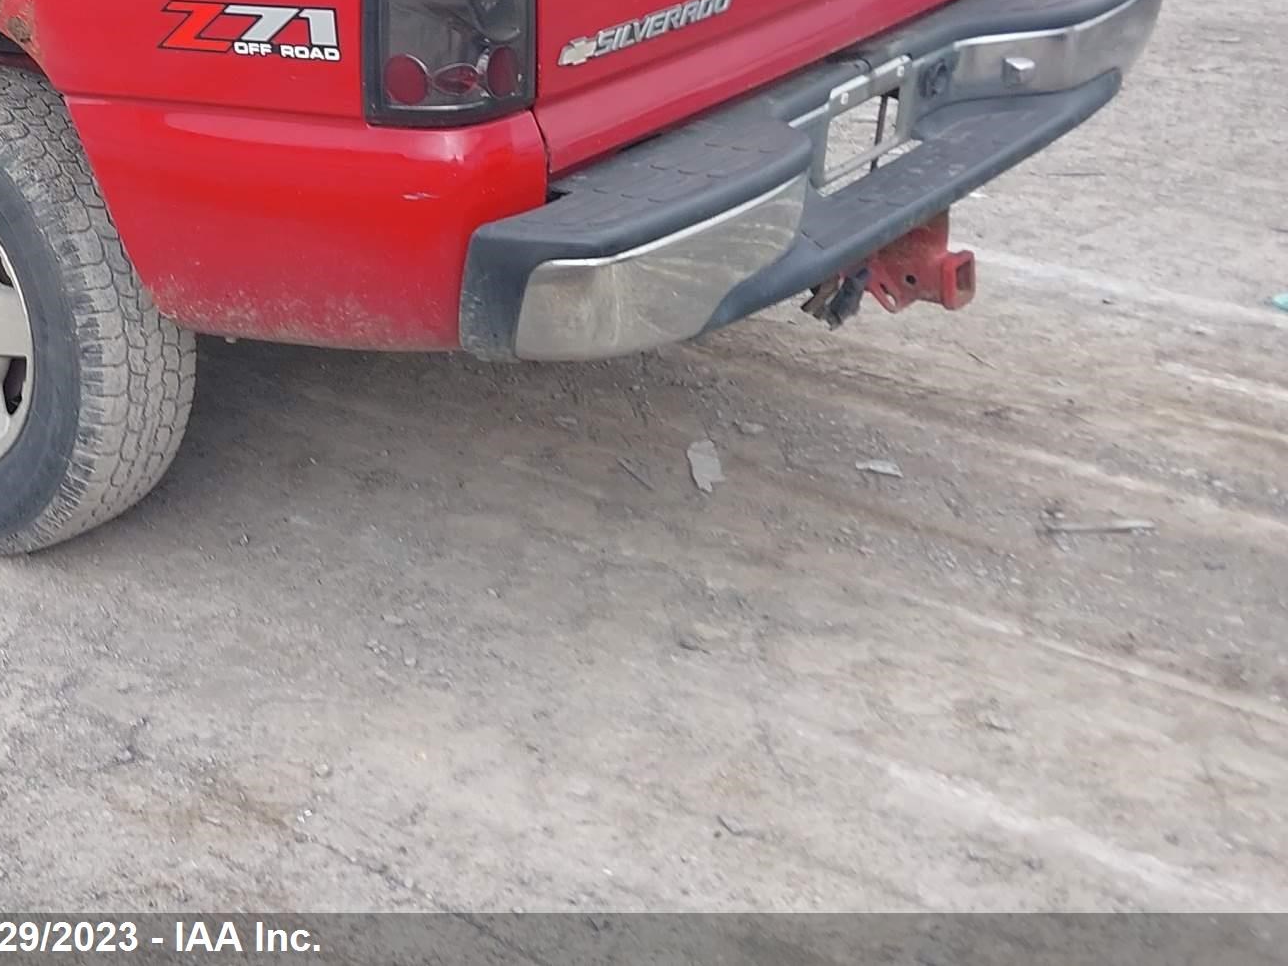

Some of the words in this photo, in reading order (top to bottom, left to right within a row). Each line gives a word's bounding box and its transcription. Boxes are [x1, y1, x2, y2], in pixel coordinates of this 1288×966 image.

[158, 0, 339, 54] Z71
[232, 41, 273, 56] OFF
[279, 44, 341, 62] ROAD
